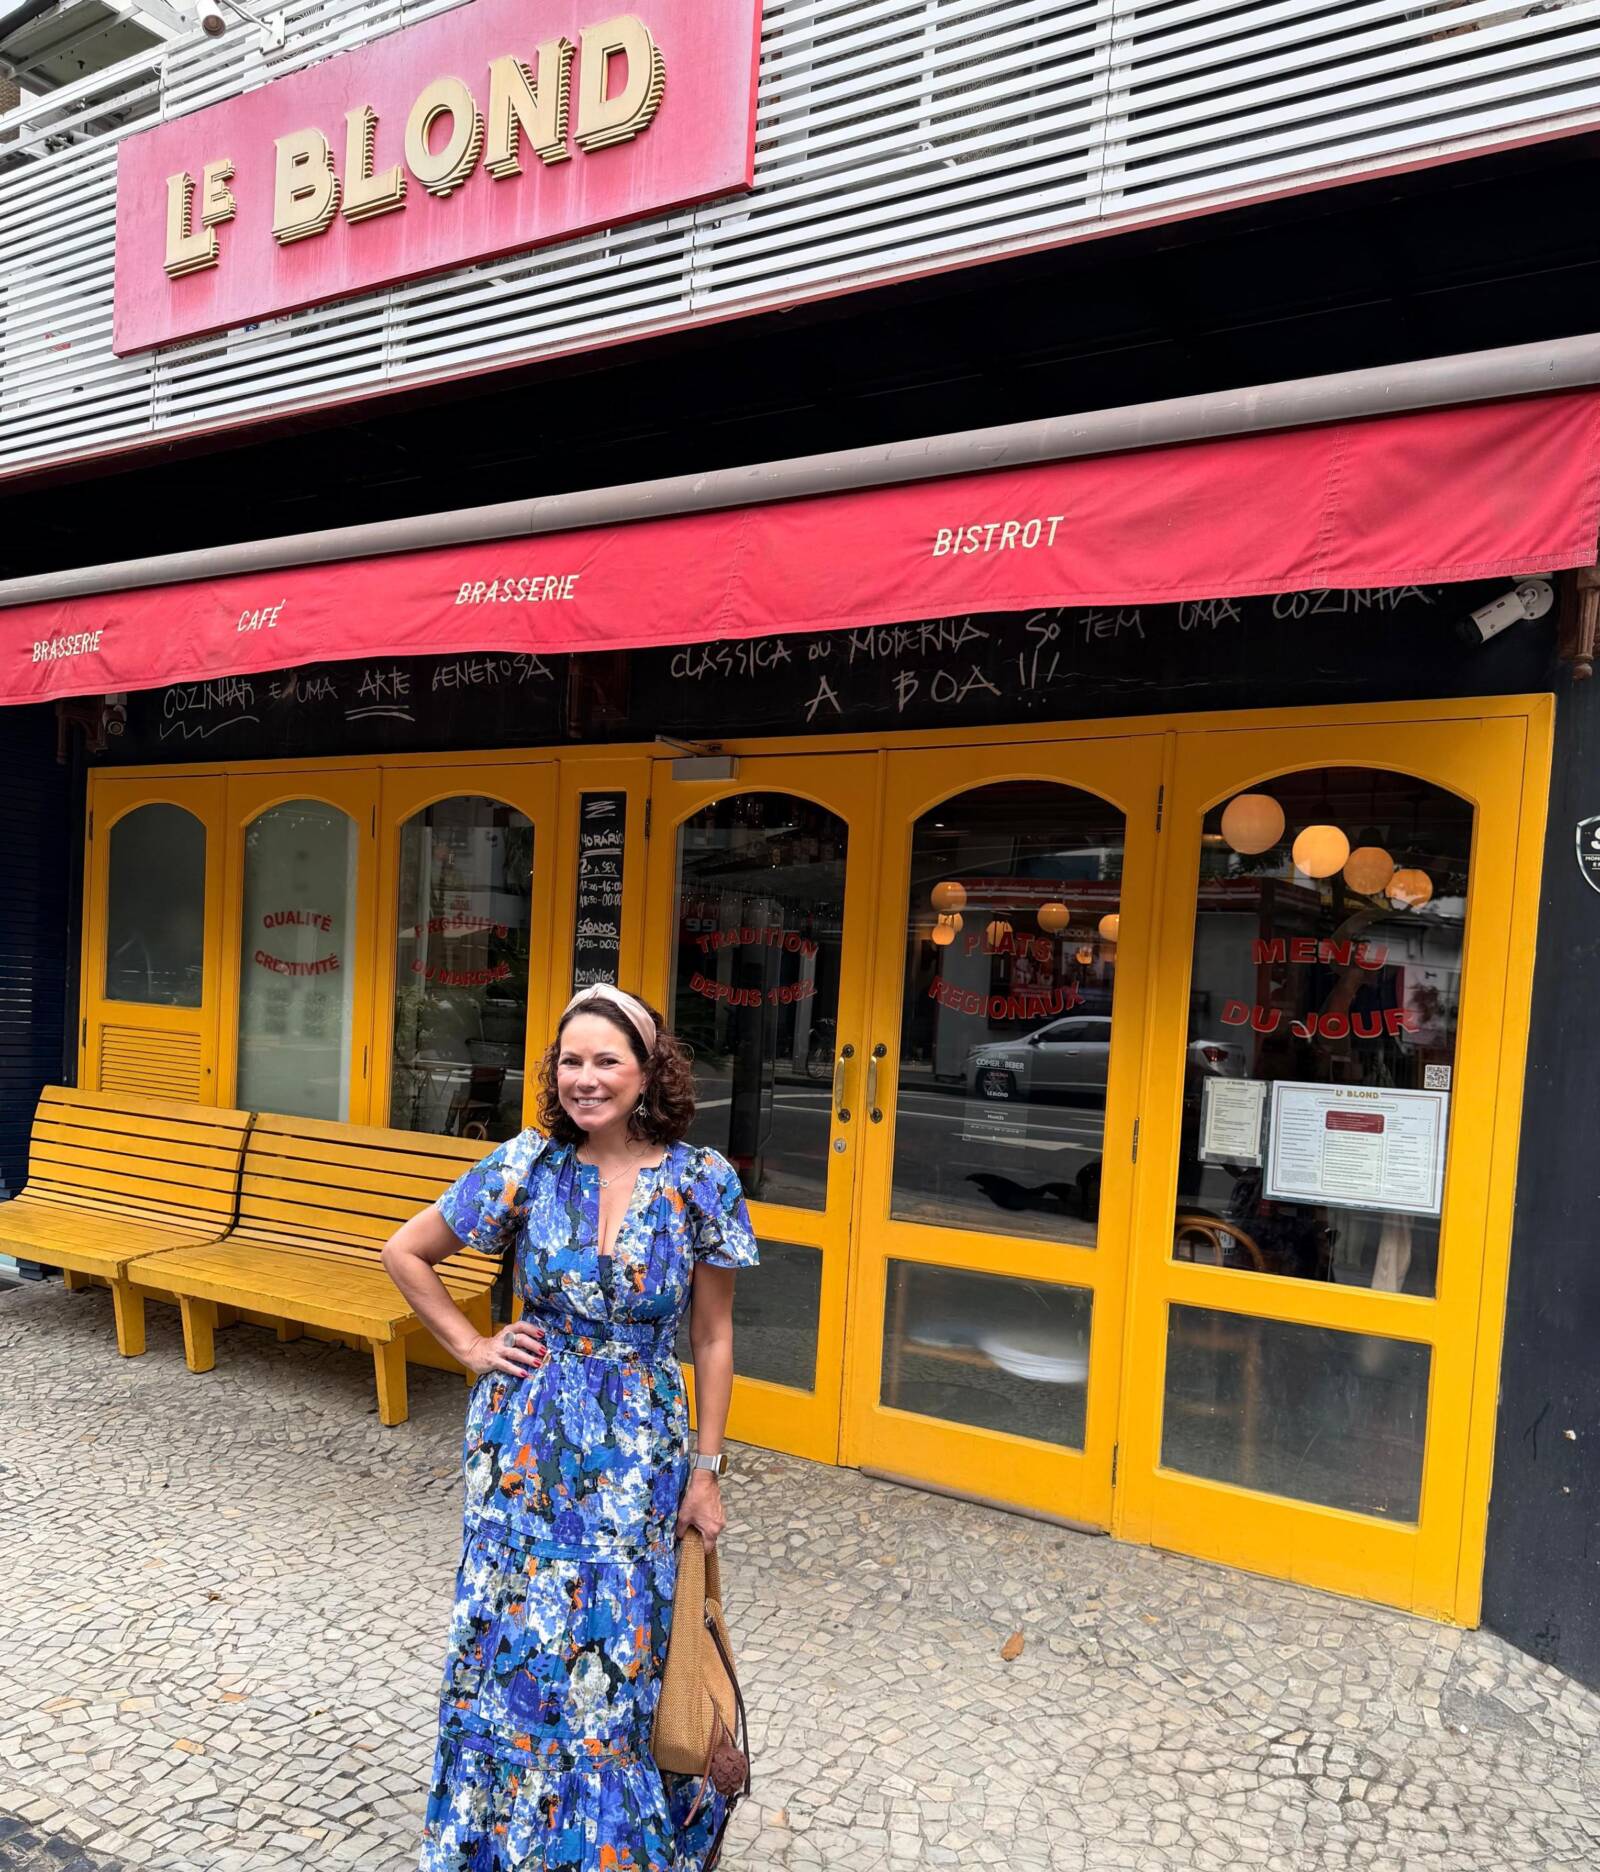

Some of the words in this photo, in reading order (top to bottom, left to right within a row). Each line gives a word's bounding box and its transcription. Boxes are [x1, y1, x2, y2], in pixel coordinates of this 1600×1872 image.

[163, 159, 237, 280] LE
[272, 14, 667, 247] BLOND
[933, 516, 1064, 557] BISTROT
[455, 574, 580, 605] BRASSERIE
[236, 600, 287, 632] CAFÉ
[1079, 608, 1146, 643] TEM
[32, 630, 104, 663] BRASSERIE
[296, 677, 339, 703] UMA
[357, 665, 411, 702] ARTE
[804, 674, 843, 723] A
[581, 828, 625, 848] HORÁRIO
[602, 860, 617, 875] SEX
[262, 909, 333, 933] QUALITÉ
[577, 918, 617, 936] SÁBADOS
[696, 926, 819, 961] TRADITION
[964, 930, 1054, 963] PLATS
[1251, 936, 1391, 972] MENU
[575, 967, 615, 985] DOMINGOS
[689, 972, 763, 1008] DEPUIS
[1220, 999, 1282, 1034] DU
[1289, 1006, 1421, 1040] JOUR
[1346, 1090, 1380, 1100] BLOND
